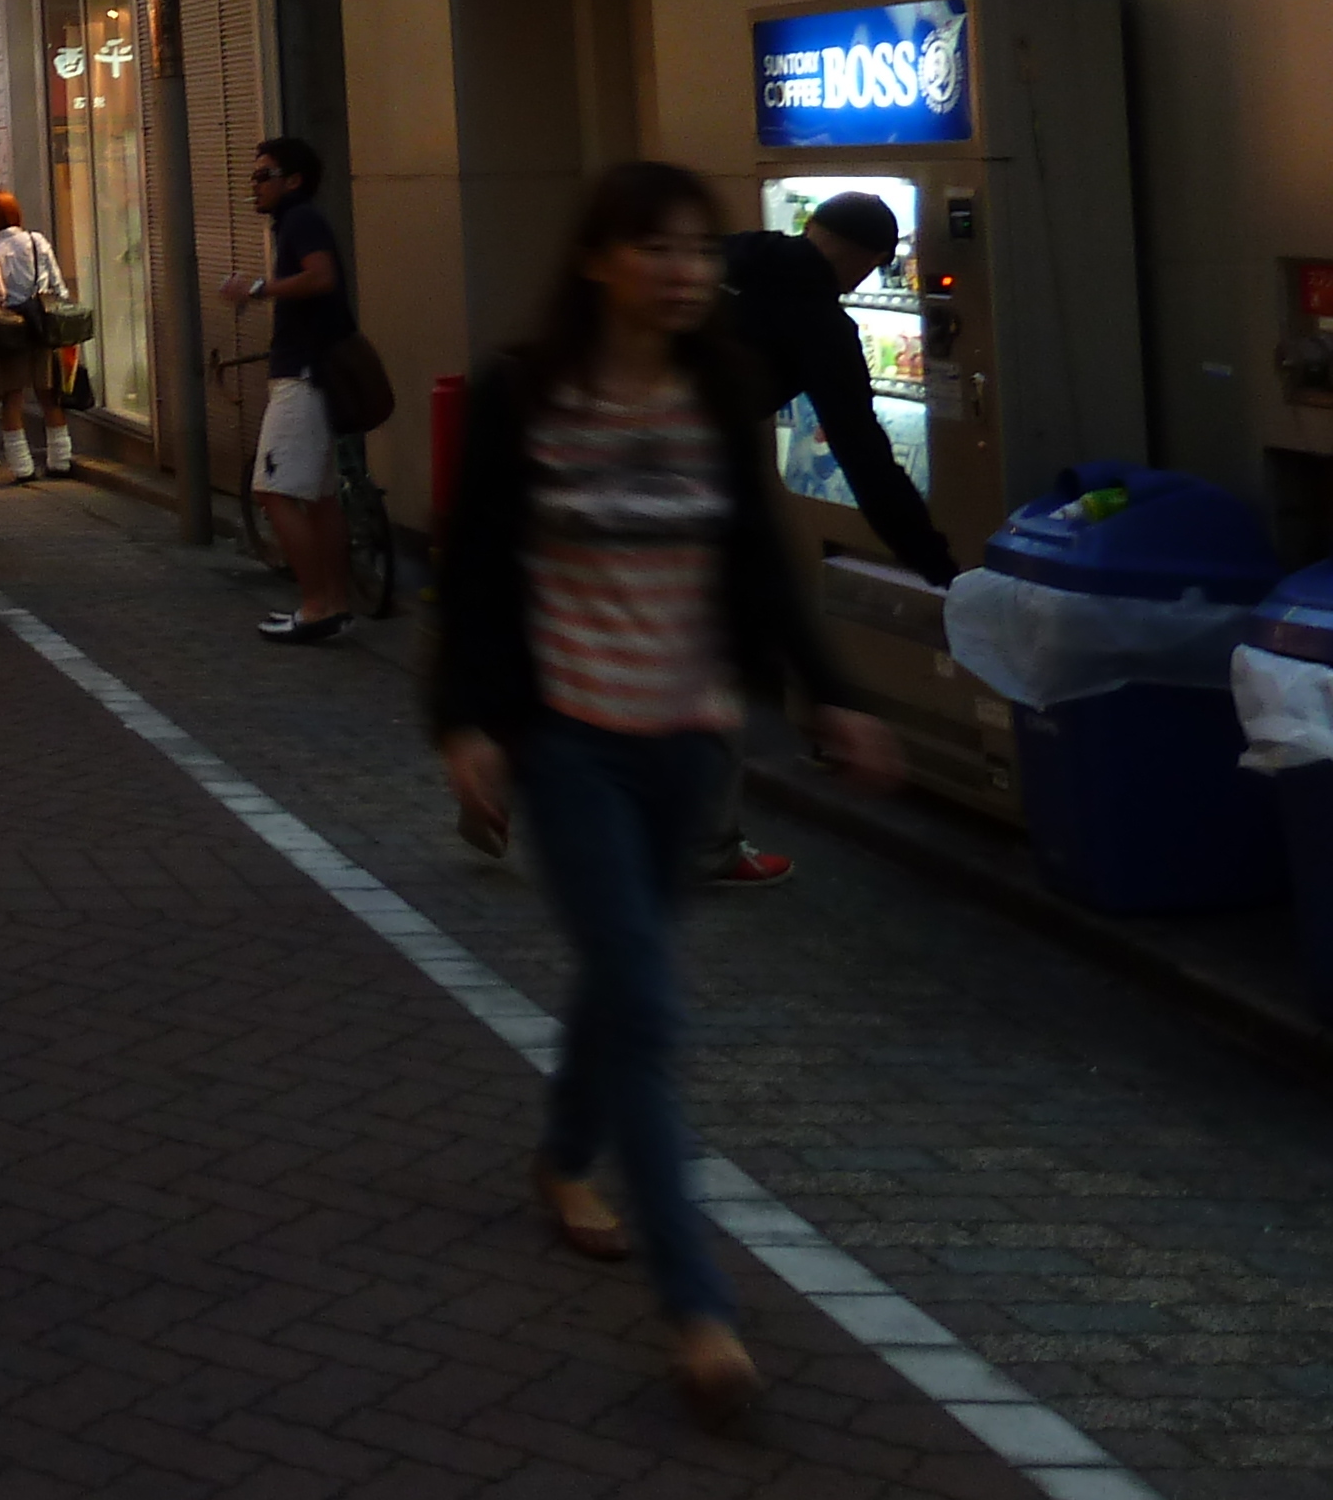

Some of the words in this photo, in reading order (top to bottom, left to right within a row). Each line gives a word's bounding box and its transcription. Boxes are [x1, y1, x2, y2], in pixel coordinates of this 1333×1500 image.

[765, 51, 820, 75] SUNTORY
[822, 40, 918, 109] BOSS
[765, 77, 822, 108] COFFEE
